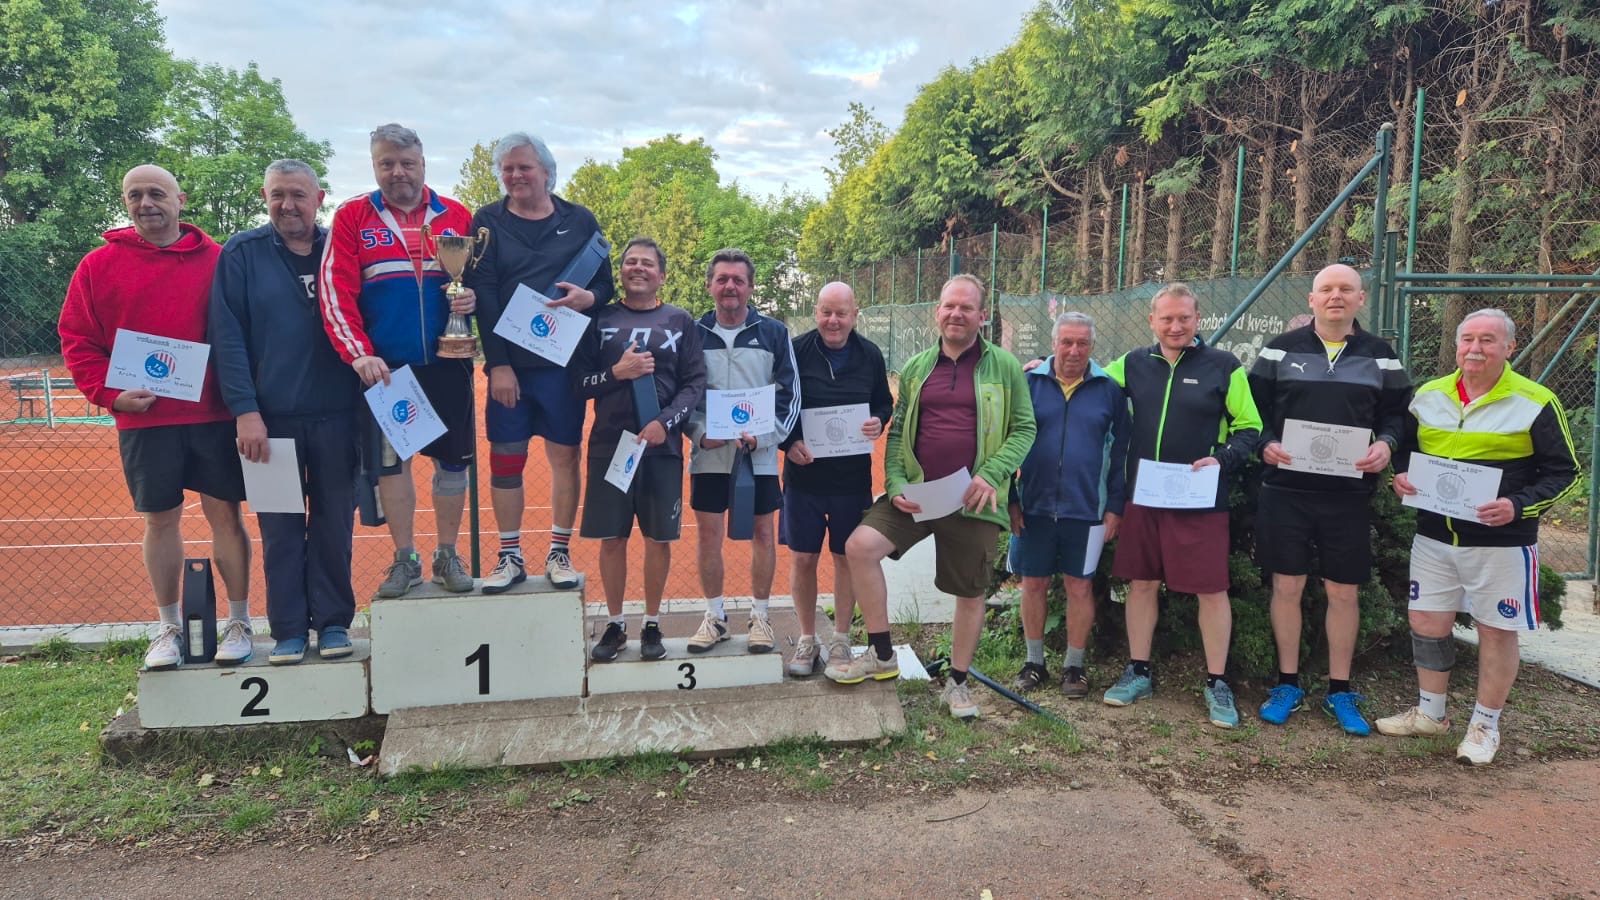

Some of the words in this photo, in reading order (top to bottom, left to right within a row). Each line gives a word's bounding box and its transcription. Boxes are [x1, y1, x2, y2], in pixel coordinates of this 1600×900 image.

[360, 228, 394, 249] 53
[1247, 313, 1284, 334] květin
[600, 328, 683, 353] FOX
[583, 371, 608, 388] FOX
[464, 643, 491, 695] 1
[677, 663, 697, 690] 3
[240, 677, 271, 717] 2
